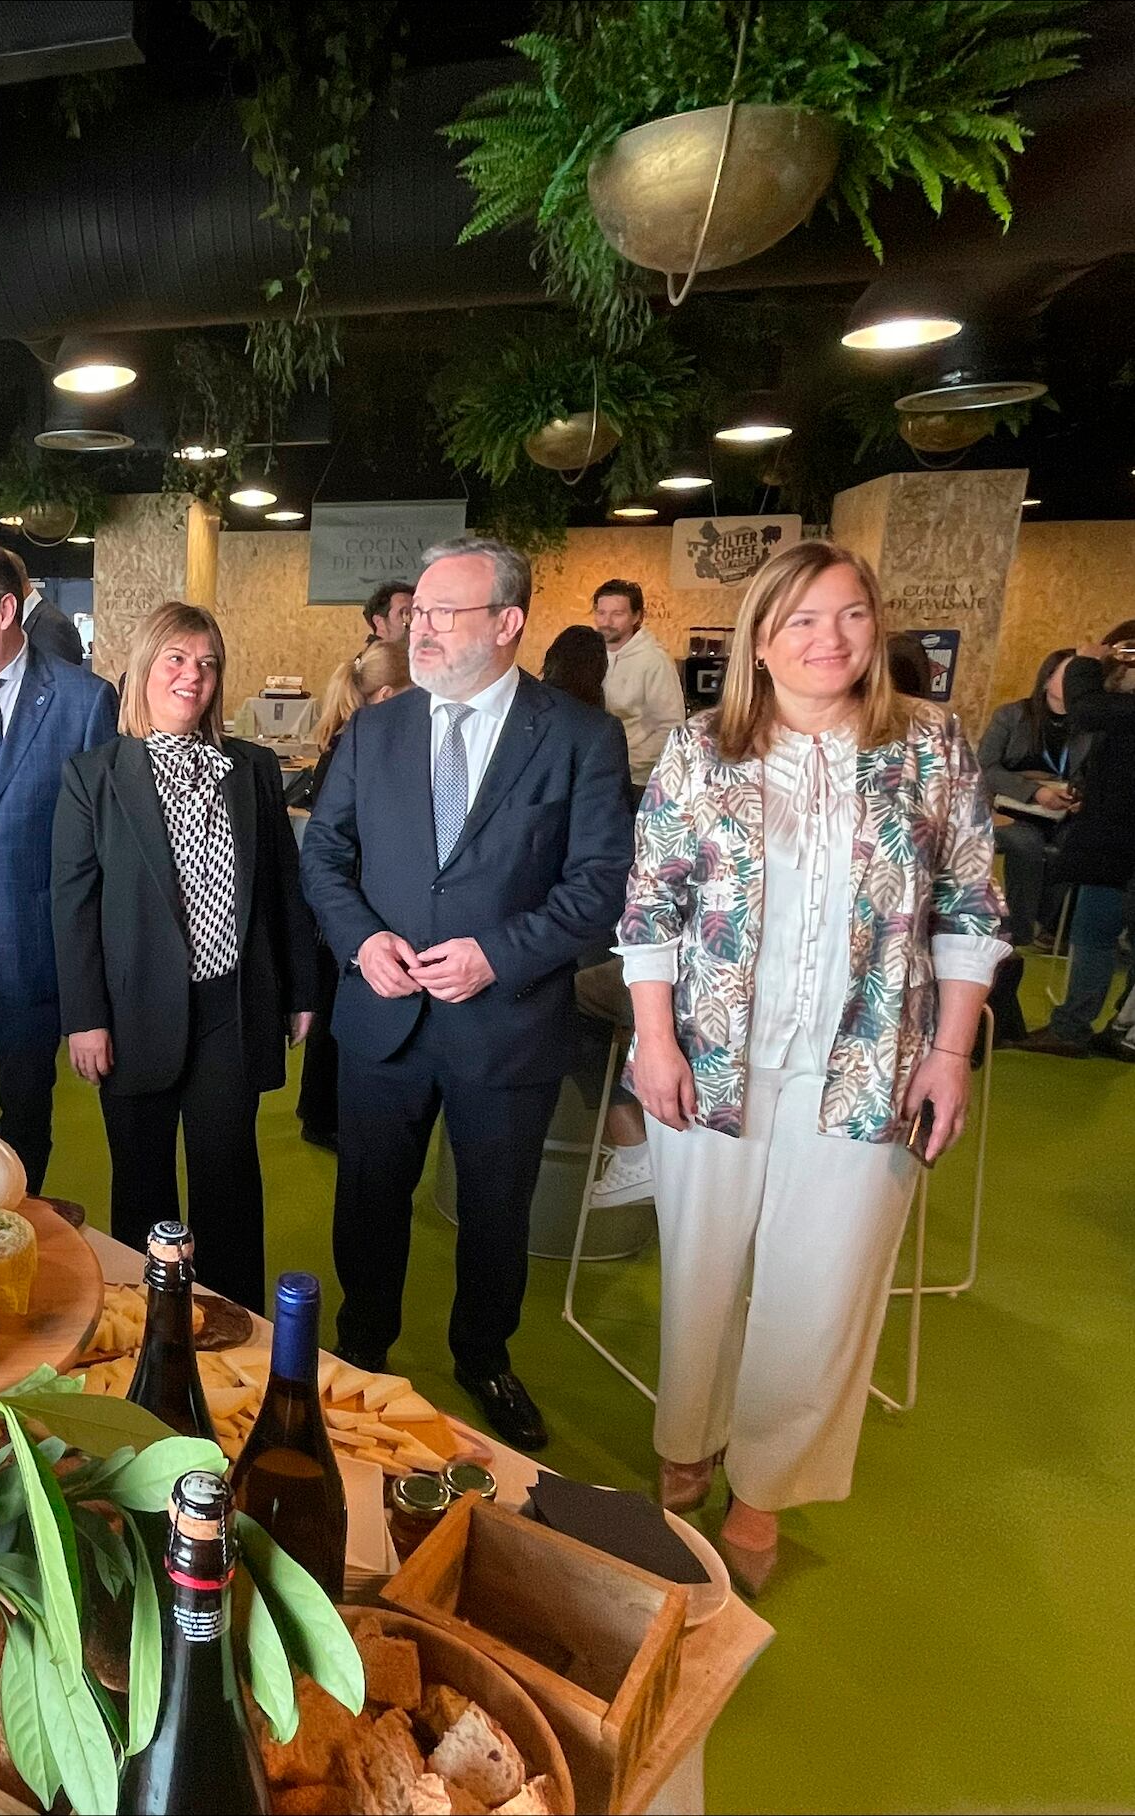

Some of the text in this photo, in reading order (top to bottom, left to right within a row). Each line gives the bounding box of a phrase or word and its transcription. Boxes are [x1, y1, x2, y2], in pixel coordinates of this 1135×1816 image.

[715, 531, 758, 550] FILTER
[714, 544, 758, 562] COFFEE
[333, 556, 419, 570] DE PAISA
[903, 584, 975, 597] COCINA
[889, 598, 913, 610] DE
